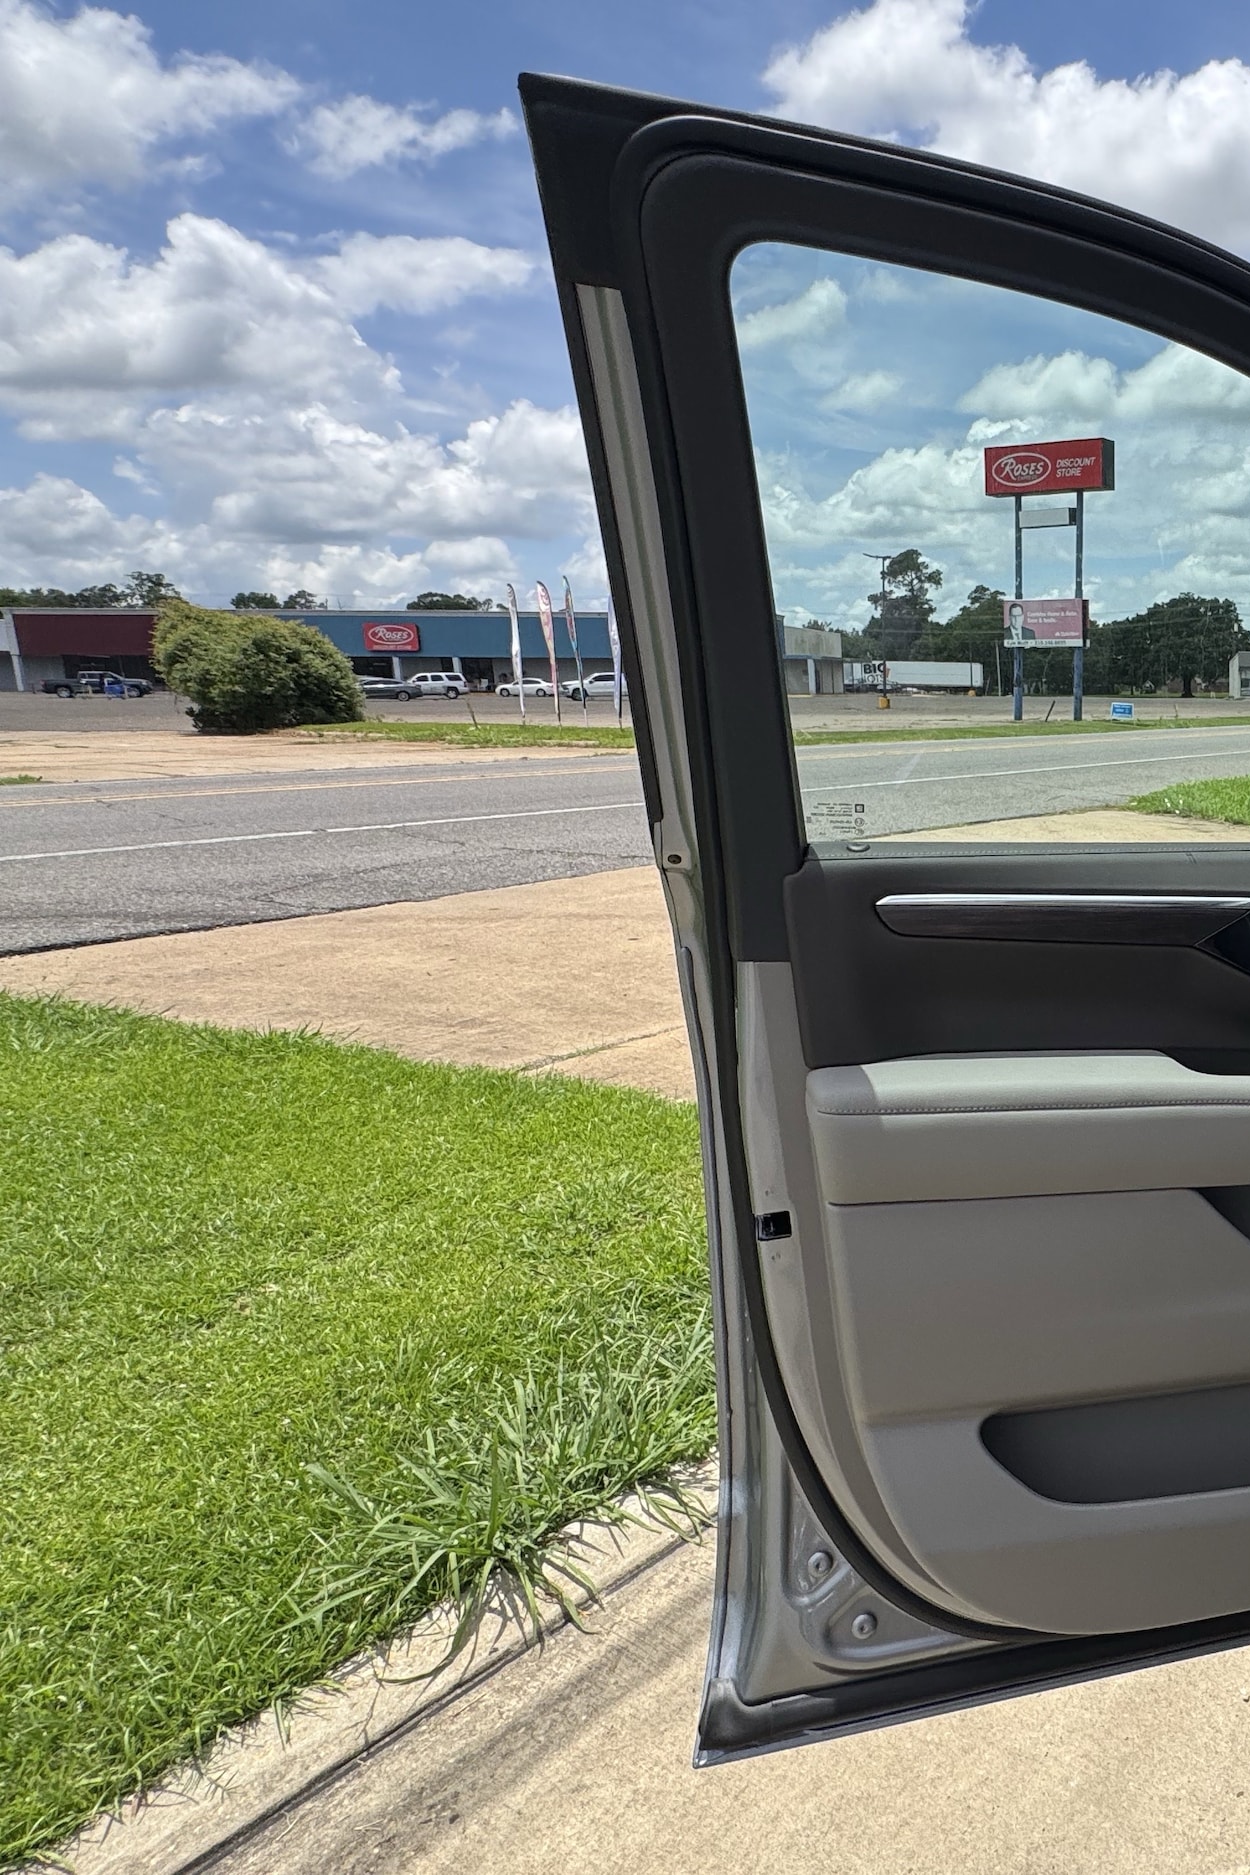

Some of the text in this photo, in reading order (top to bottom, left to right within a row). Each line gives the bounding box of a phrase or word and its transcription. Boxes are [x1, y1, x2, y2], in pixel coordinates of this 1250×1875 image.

[1000, 457, 1044, 480] ROSES
[1056, 457, 1096, 468] DISCOUNT
[1056, 467, 1082, 478] STORE
[375, 627, 409, 641] ROSES
